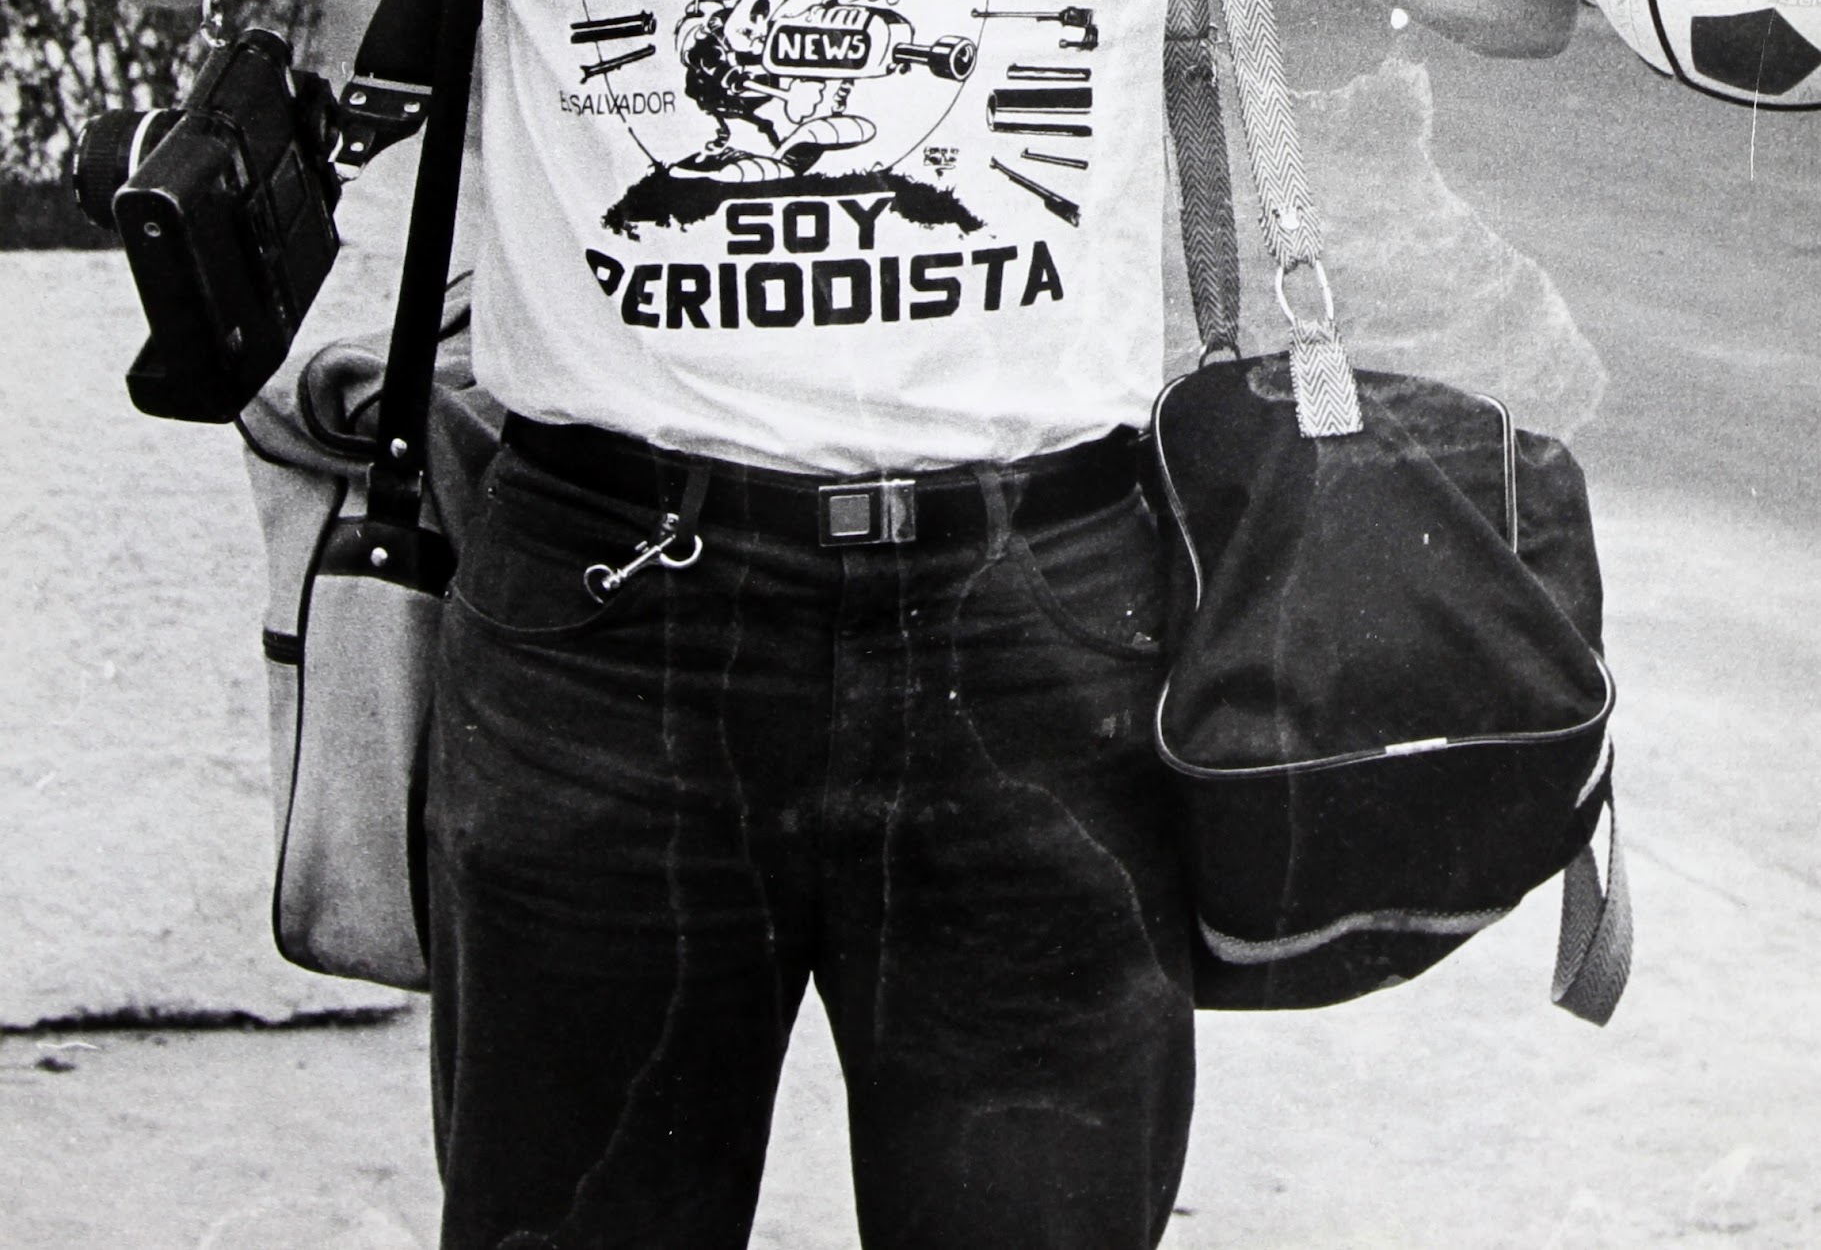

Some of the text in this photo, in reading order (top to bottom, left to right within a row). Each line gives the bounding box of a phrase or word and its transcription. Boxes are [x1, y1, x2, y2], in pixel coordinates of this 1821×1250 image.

[777, 32, 867, 61] NEWS
[569, 91, 676, 116] SALVADOR
[725, 198, 892, 256] SOY
[585, 240, 1065, 330] PERIODISTA
